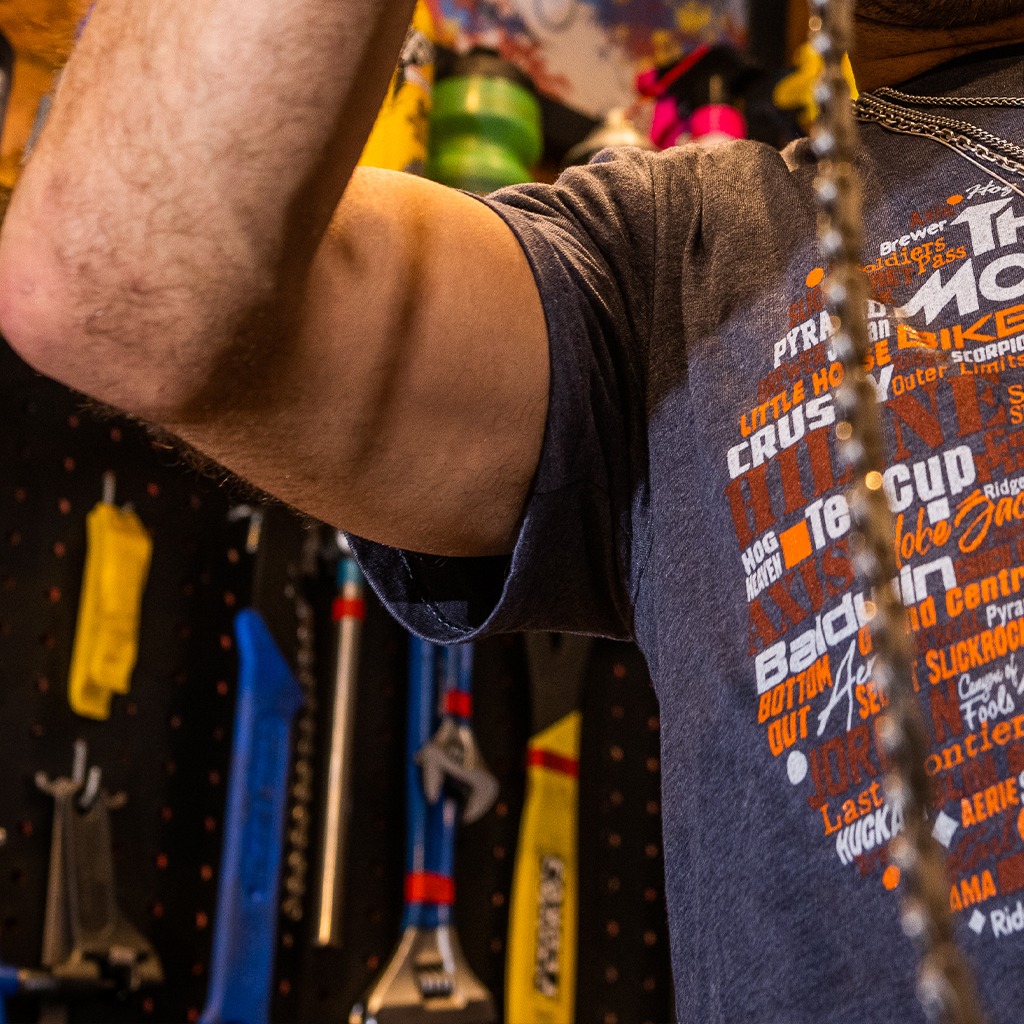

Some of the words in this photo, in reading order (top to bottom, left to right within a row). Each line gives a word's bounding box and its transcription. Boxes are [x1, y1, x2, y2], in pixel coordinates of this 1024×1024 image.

[859, 236, 946, 273] oldiers
[918, 245, 967, 275] Pass
[880, 219, 947, 257] Brewer
[773, 299, 887, 370] PYRAD
[740, 379, 806, 438] LITTLE
[811, 338, 892, 397] HOSE
[892, 365, 949, 396] Outer
[727, 363, 895, 480] CRUSY
[805, 494, 856, 550] Te
[741, 531, 781, 576] HOG
[745, 552, 783, 603] HEAVEN
[754, 555, 958, 696] Baldin
[757, 652, 833, 725] BOTTOM
[767, 704, 812, 757] OUT
[820, 780, 885, 836] Last
[960, 776, 1020, 829] AERIE
[835, 799, 908, 866] HUCKA
[949, 868, 997, 913] AMA
